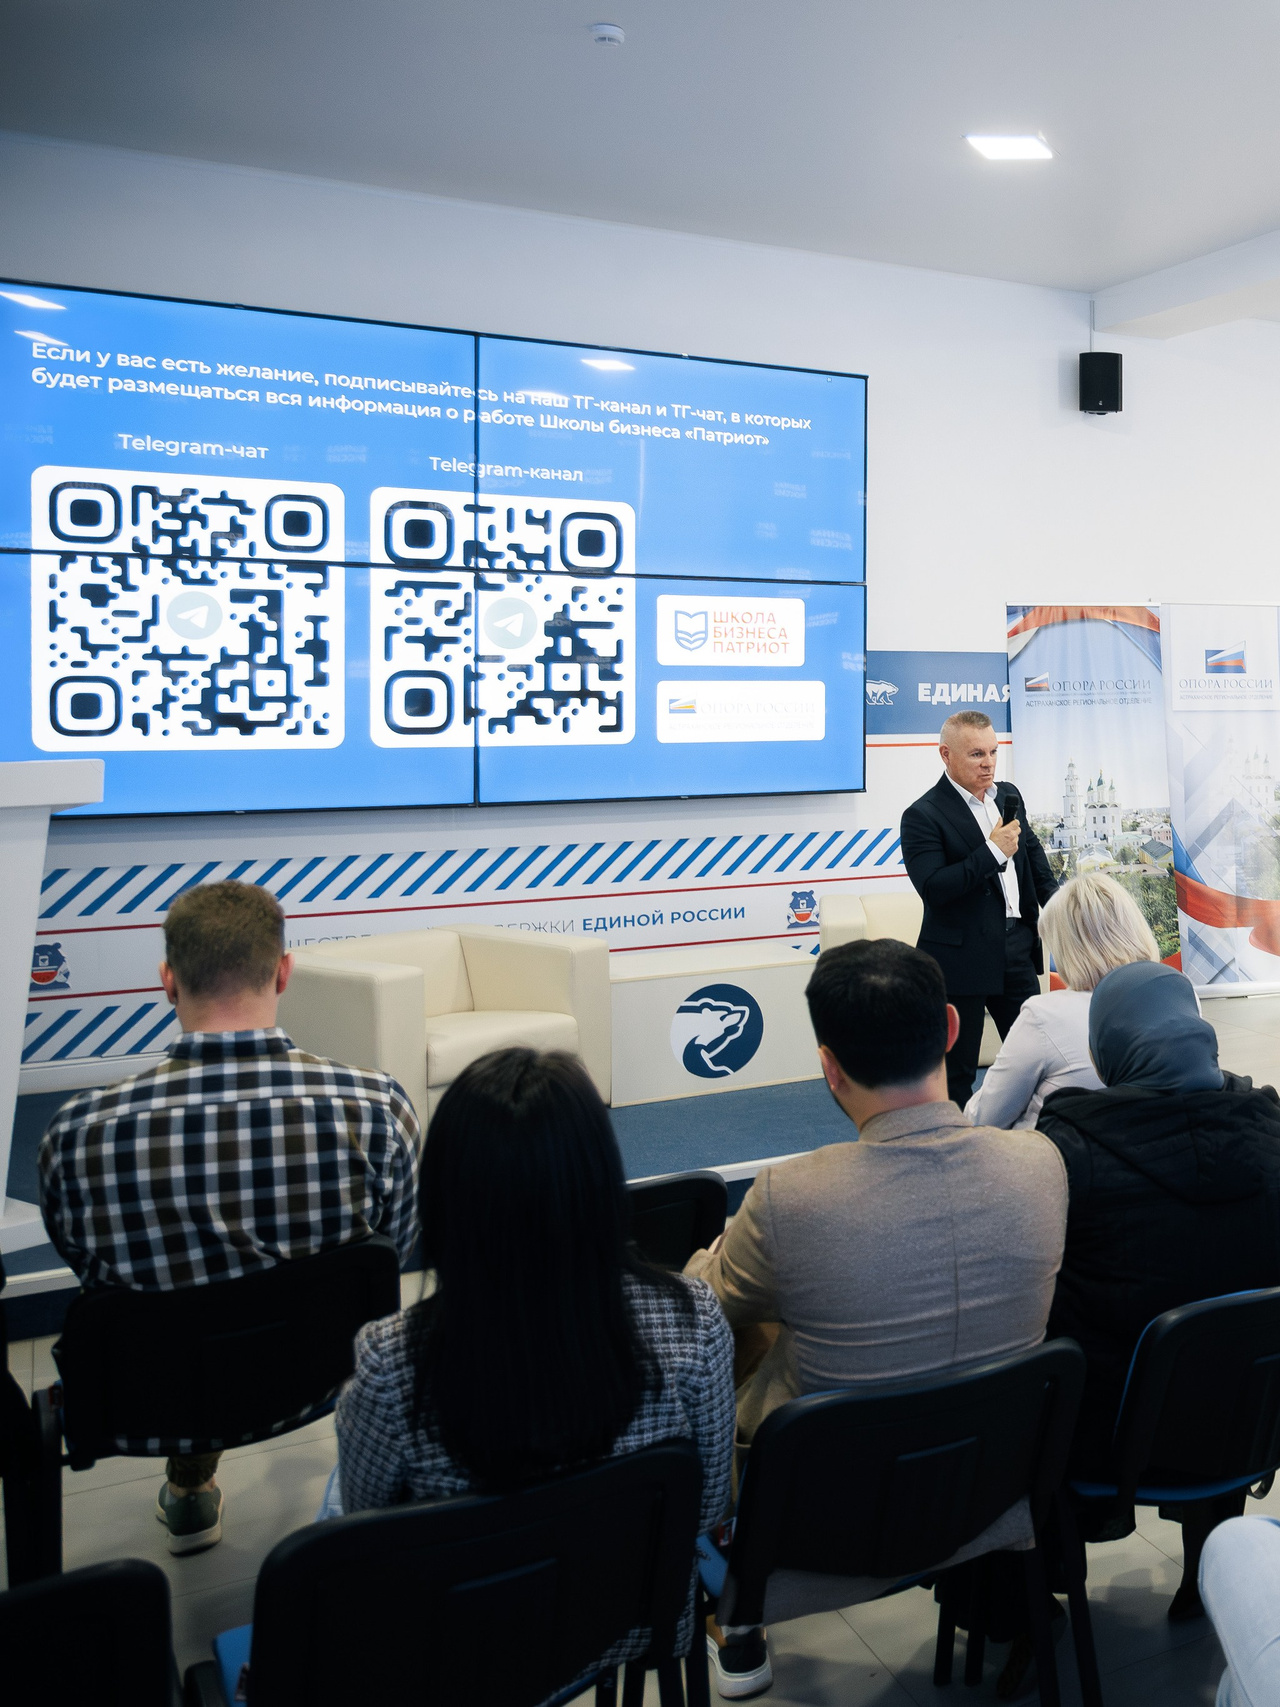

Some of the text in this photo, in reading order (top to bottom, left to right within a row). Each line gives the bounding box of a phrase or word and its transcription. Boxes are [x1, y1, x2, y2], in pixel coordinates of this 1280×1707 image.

[31, 341, 812, 431] Если у вас есть желание, подписывайтесь на наш ТГ-канал и ТГ-чат, в которых
[31, 366, 770, 447] будет размещаться вся информация о работе Школы бизнеса «Патриот»
[118, 432, 270, 460] Telegram-чат
[429, 456, 584, 484] Telegram-канал
[713, 611, 777, 625] ШКОЛА
[713, 626, 789, 640] БИЗНЕСА
[713, 641, 791, 655] ПАТРИОТ
[918, 682, 1010, 705] ЕДИНАЯ
[1052, 679, 1152, 692] ОПОРА РОССИИ
[1179, 679, 1221, 689] ОПОРА
[582, 909, 664, 932] ЕДИНОЙ
[670, 906, 746, 925] РОССИИ
